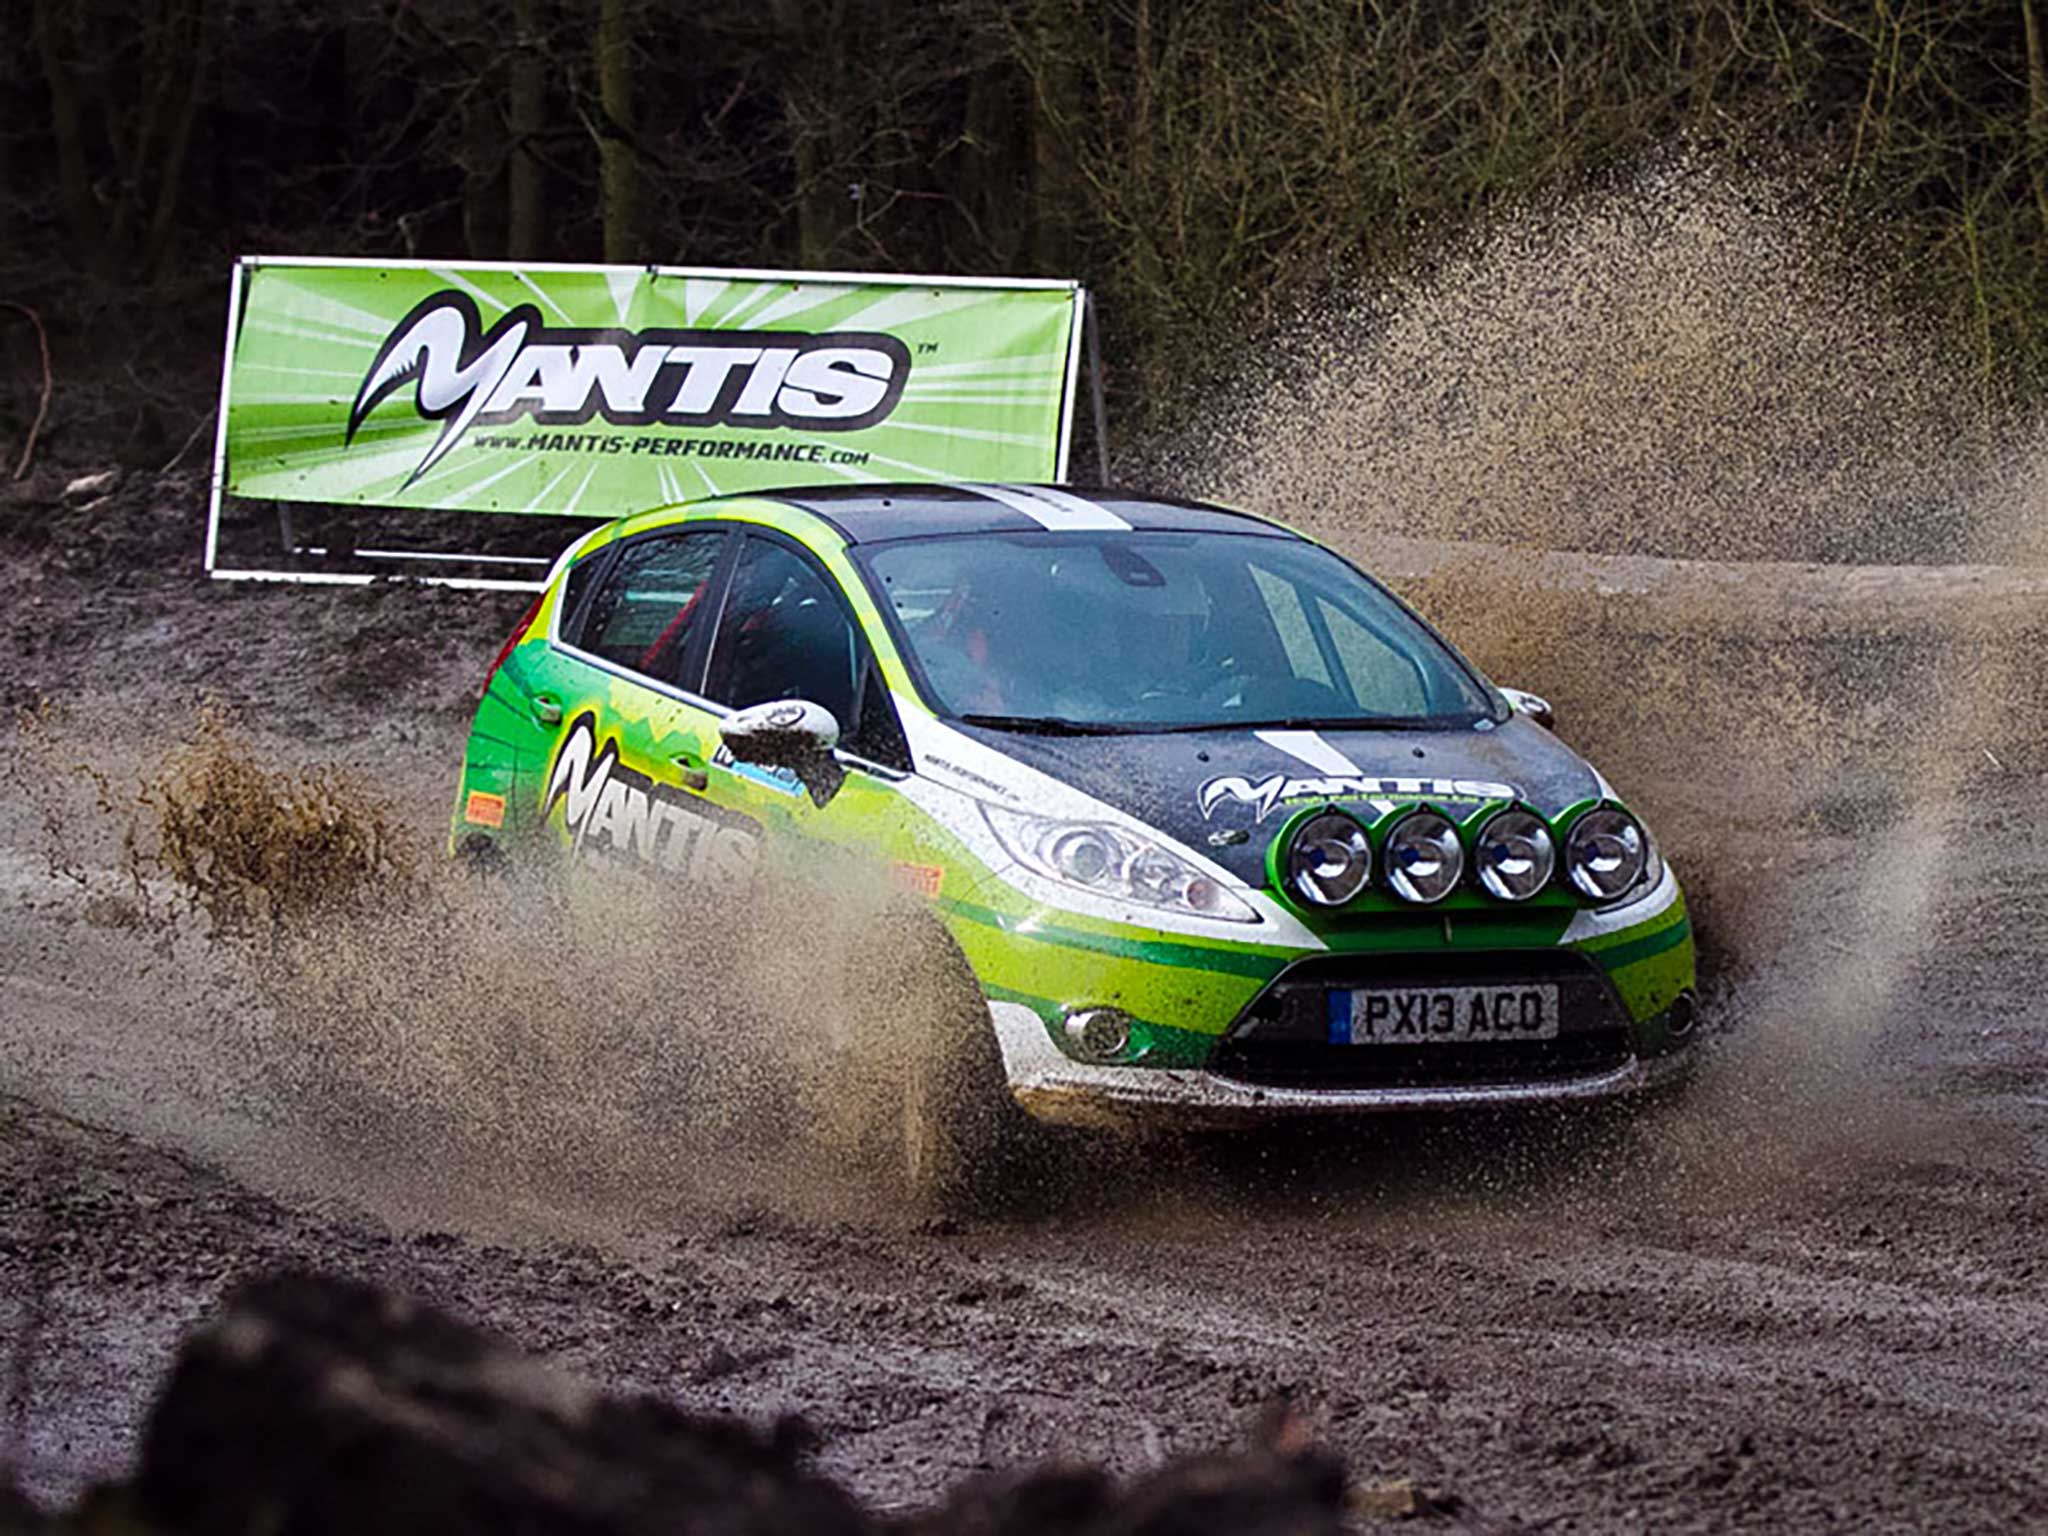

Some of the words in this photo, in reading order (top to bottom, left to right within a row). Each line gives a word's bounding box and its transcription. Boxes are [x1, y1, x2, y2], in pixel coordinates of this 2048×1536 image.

[347, 290, 911, 494] MANTIS
[542, 711, 764, 877] MANTIS
[1199, 777, 1525, 822] MANTIS
[1365, 993, 1455, 1036] PX13
